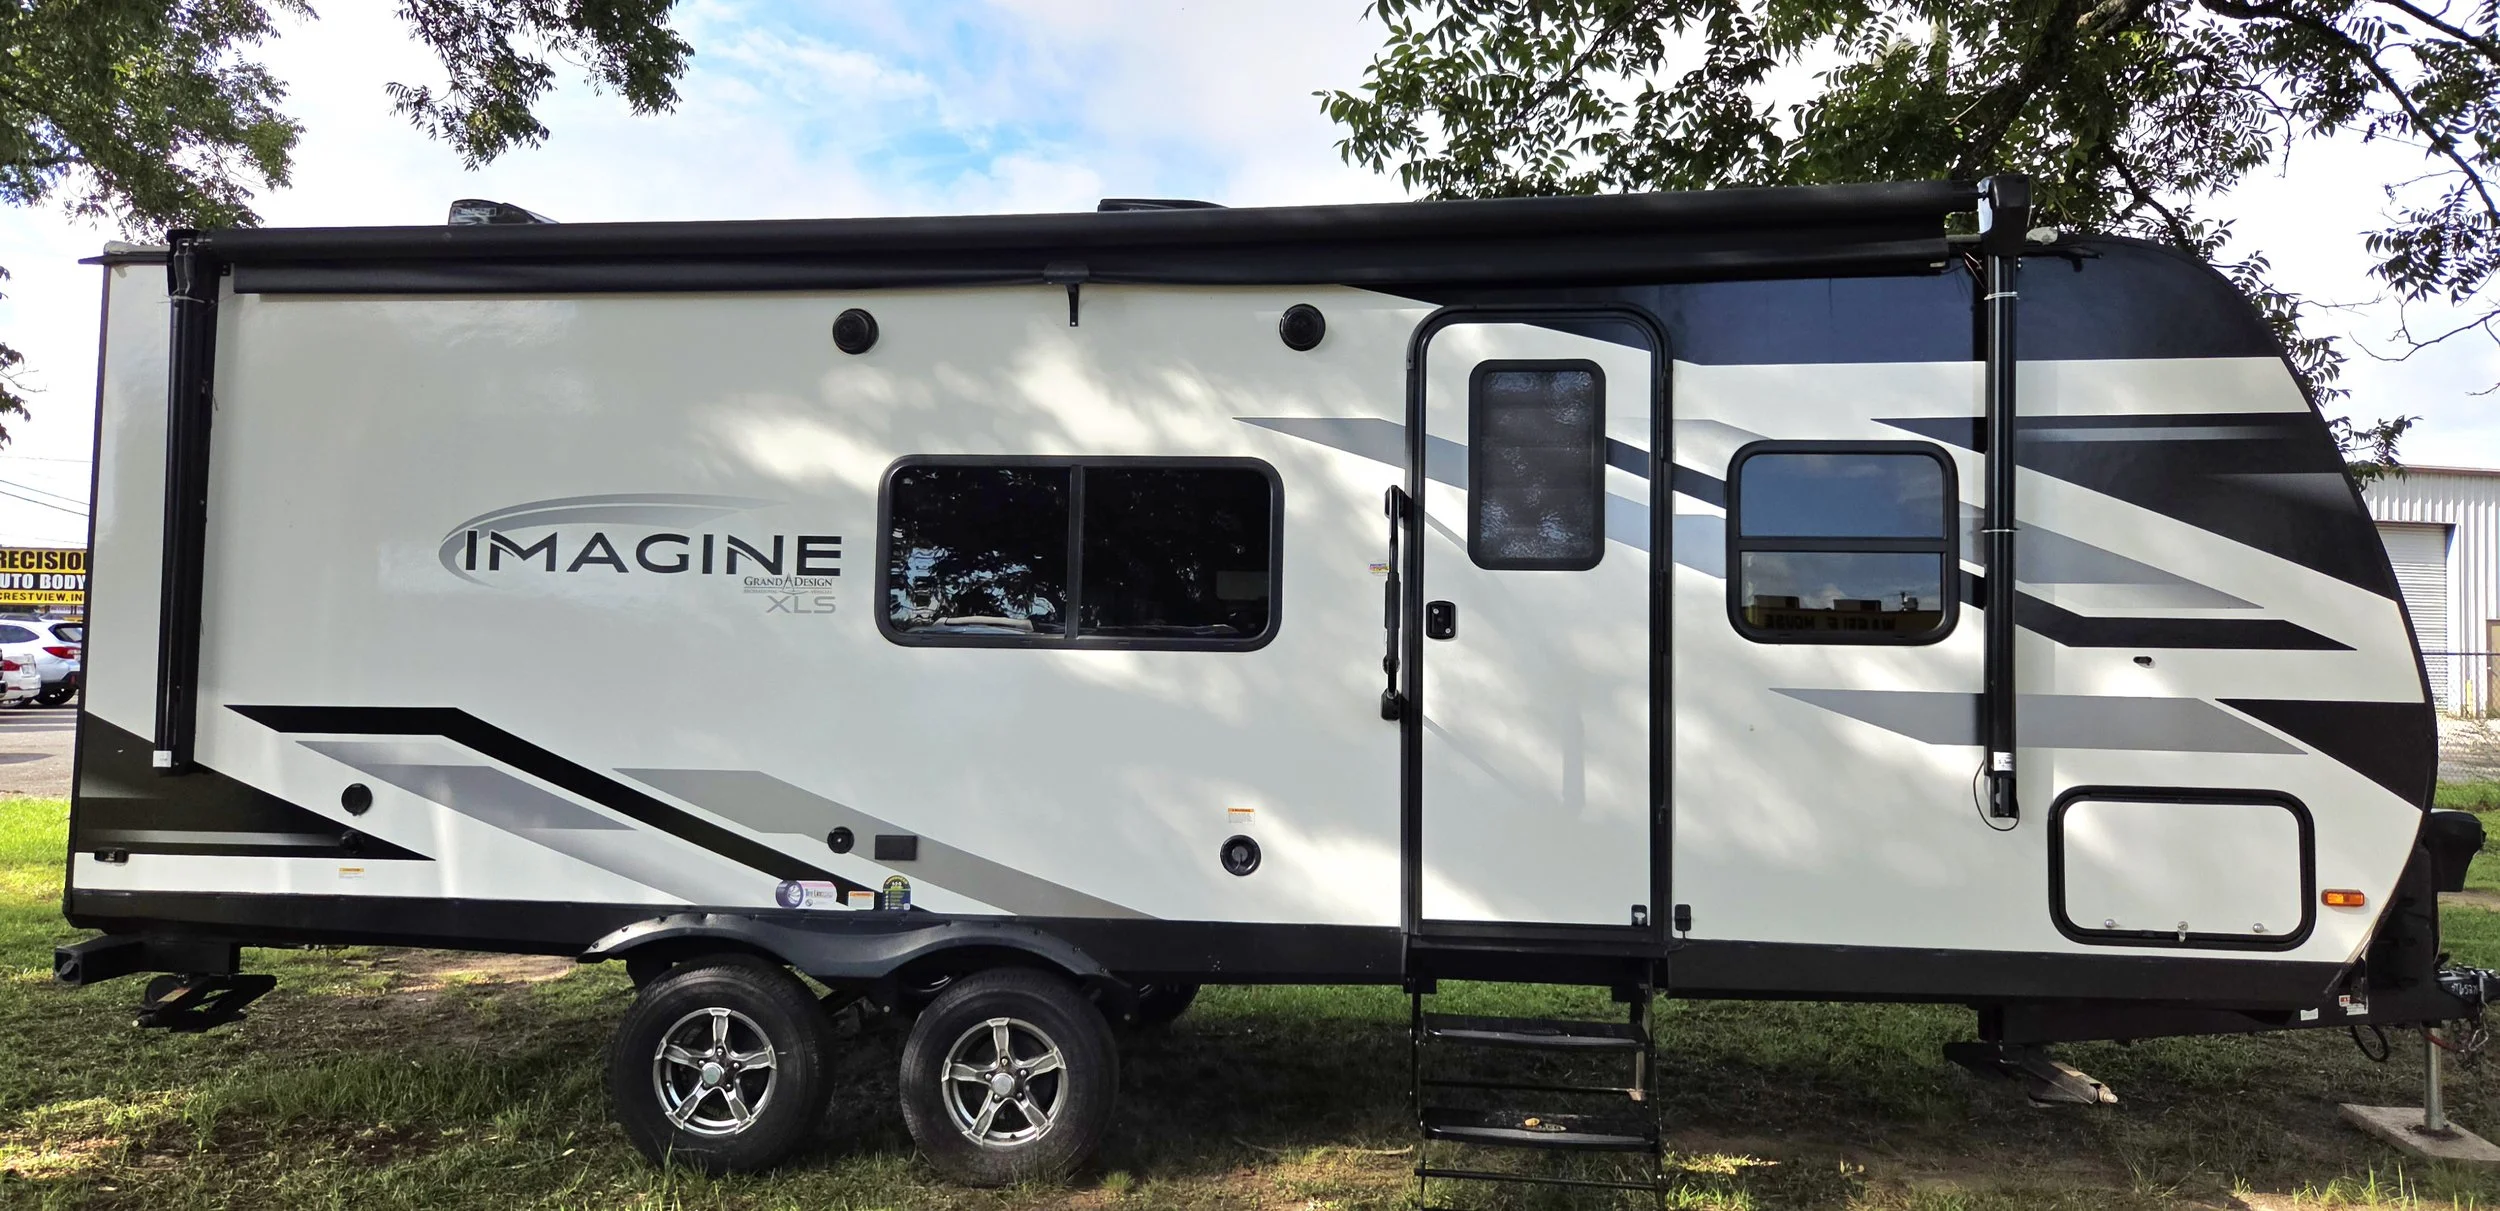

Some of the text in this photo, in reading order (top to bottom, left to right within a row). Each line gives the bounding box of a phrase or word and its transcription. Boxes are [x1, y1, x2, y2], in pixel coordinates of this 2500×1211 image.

[0, 550, 86, 570] RECISIO
[464, 529, 842, 577] IMAGINE
[39, 573, 86, 590] BODY
[743, 575, 833, 587] GRAND DESIGN
[765, 595, 837, 614] XLS
